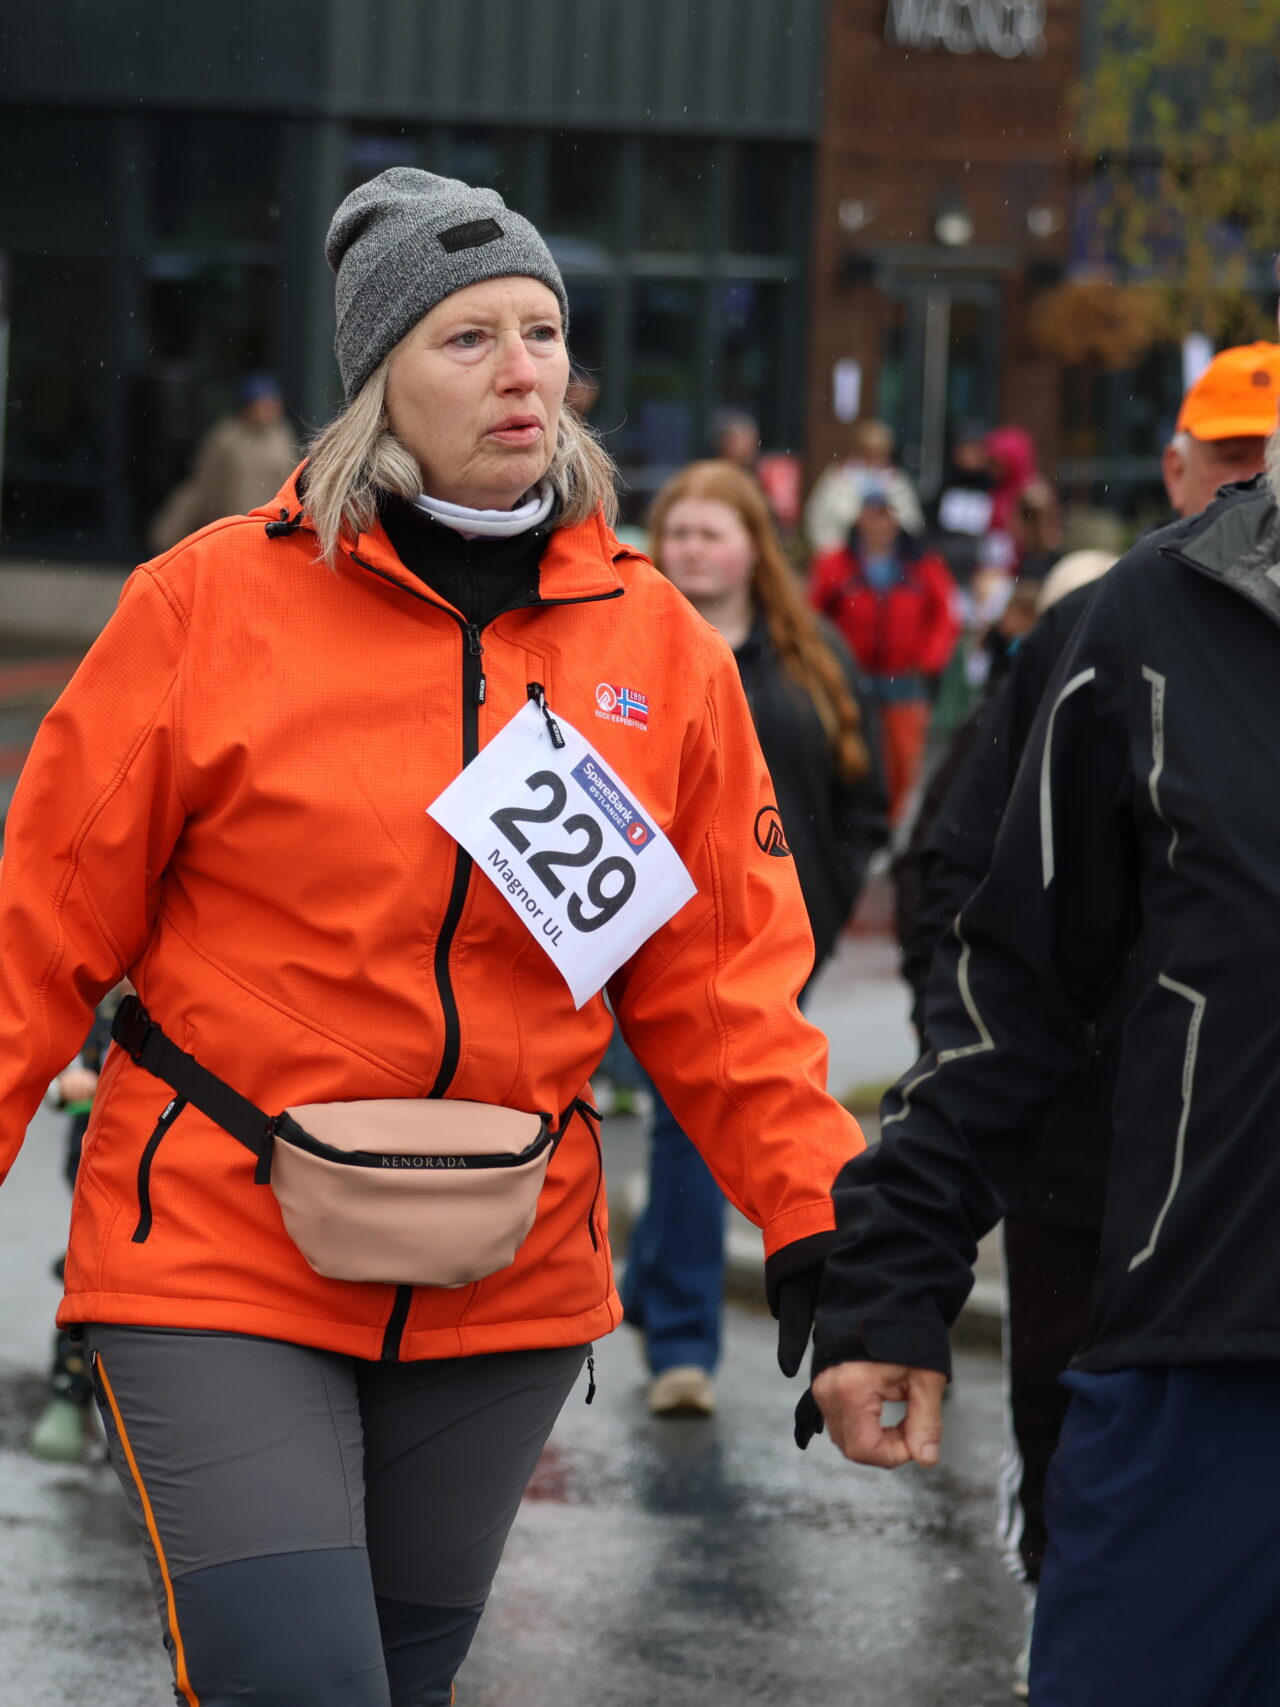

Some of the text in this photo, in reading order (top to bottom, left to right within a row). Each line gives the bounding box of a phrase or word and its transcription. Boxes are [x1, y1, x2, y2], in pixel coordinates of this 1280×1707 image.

[583, 762, 644, 840] SpareBank 1
[589, 785, 627, 829] ØSTLANDET
[489, 770, 636, 933] 229
[487, 848, 563, 948] Magnor UL
[382, 1156, 467, 1168] KENORADA
